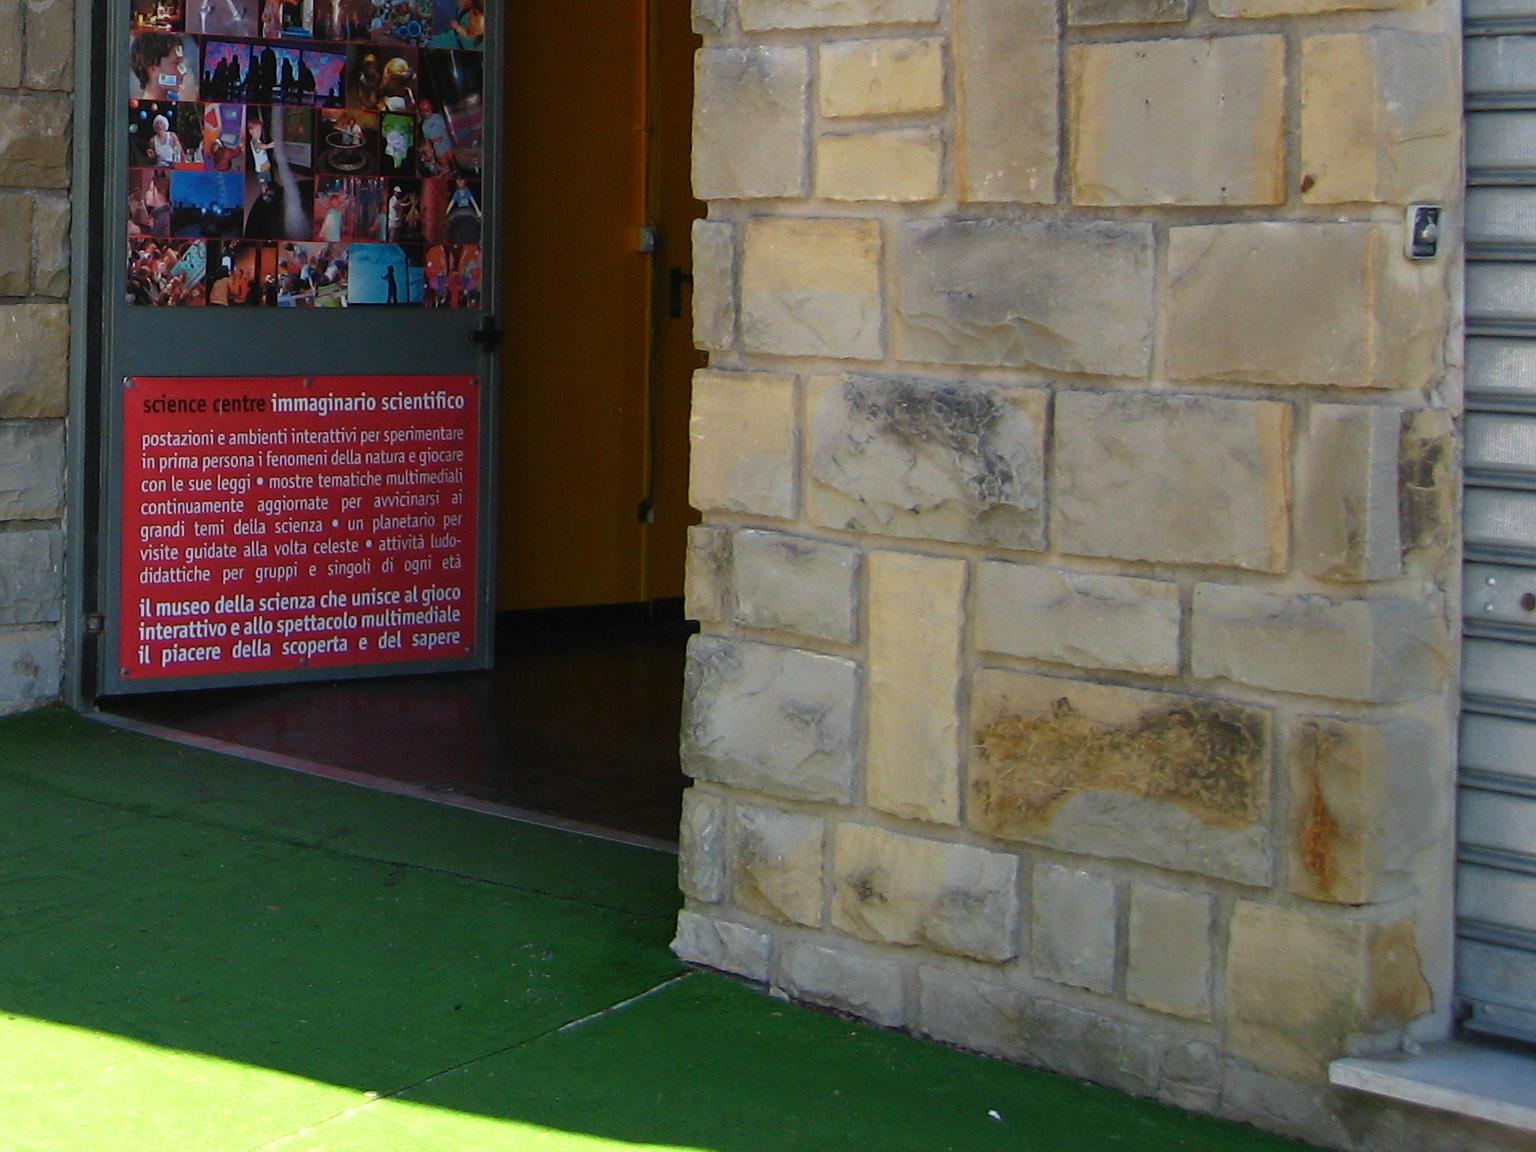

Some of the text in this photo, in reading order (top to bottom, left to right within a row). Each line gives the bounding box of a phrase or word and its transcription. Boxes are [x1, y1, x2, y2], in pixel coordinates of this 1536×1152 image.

[144, 391, 464, 415] science centre immaginario scientifico
[142, 427, 464, 450] postazioni e ambienti interattivi per sperimentare
[142, 449, 463, 472] in prima persona i fenomeni della natura e giocare
[142, 470, 462, 494] con le sue leggi mostre tematiche multimediali
[141, 490, 462, 516] continuamente aggiornate per avvicinarsi ai
[141, 514, 462, 540] grandi temi della scienza un planetario per
[140, 533, 462, 561] visite guidate alla volta celeste attività ludo-
[140, 555, 461, 584] didattiche per gruppi e singoli di ogni età
[139, 586, 461, 617] il museo della scienza che unisce al gioco
[139, 607, 460, 640] interattivo e allo spettacolo multimediale
[138, 631, 460, 666] il piacere della scoperta e del sapere
